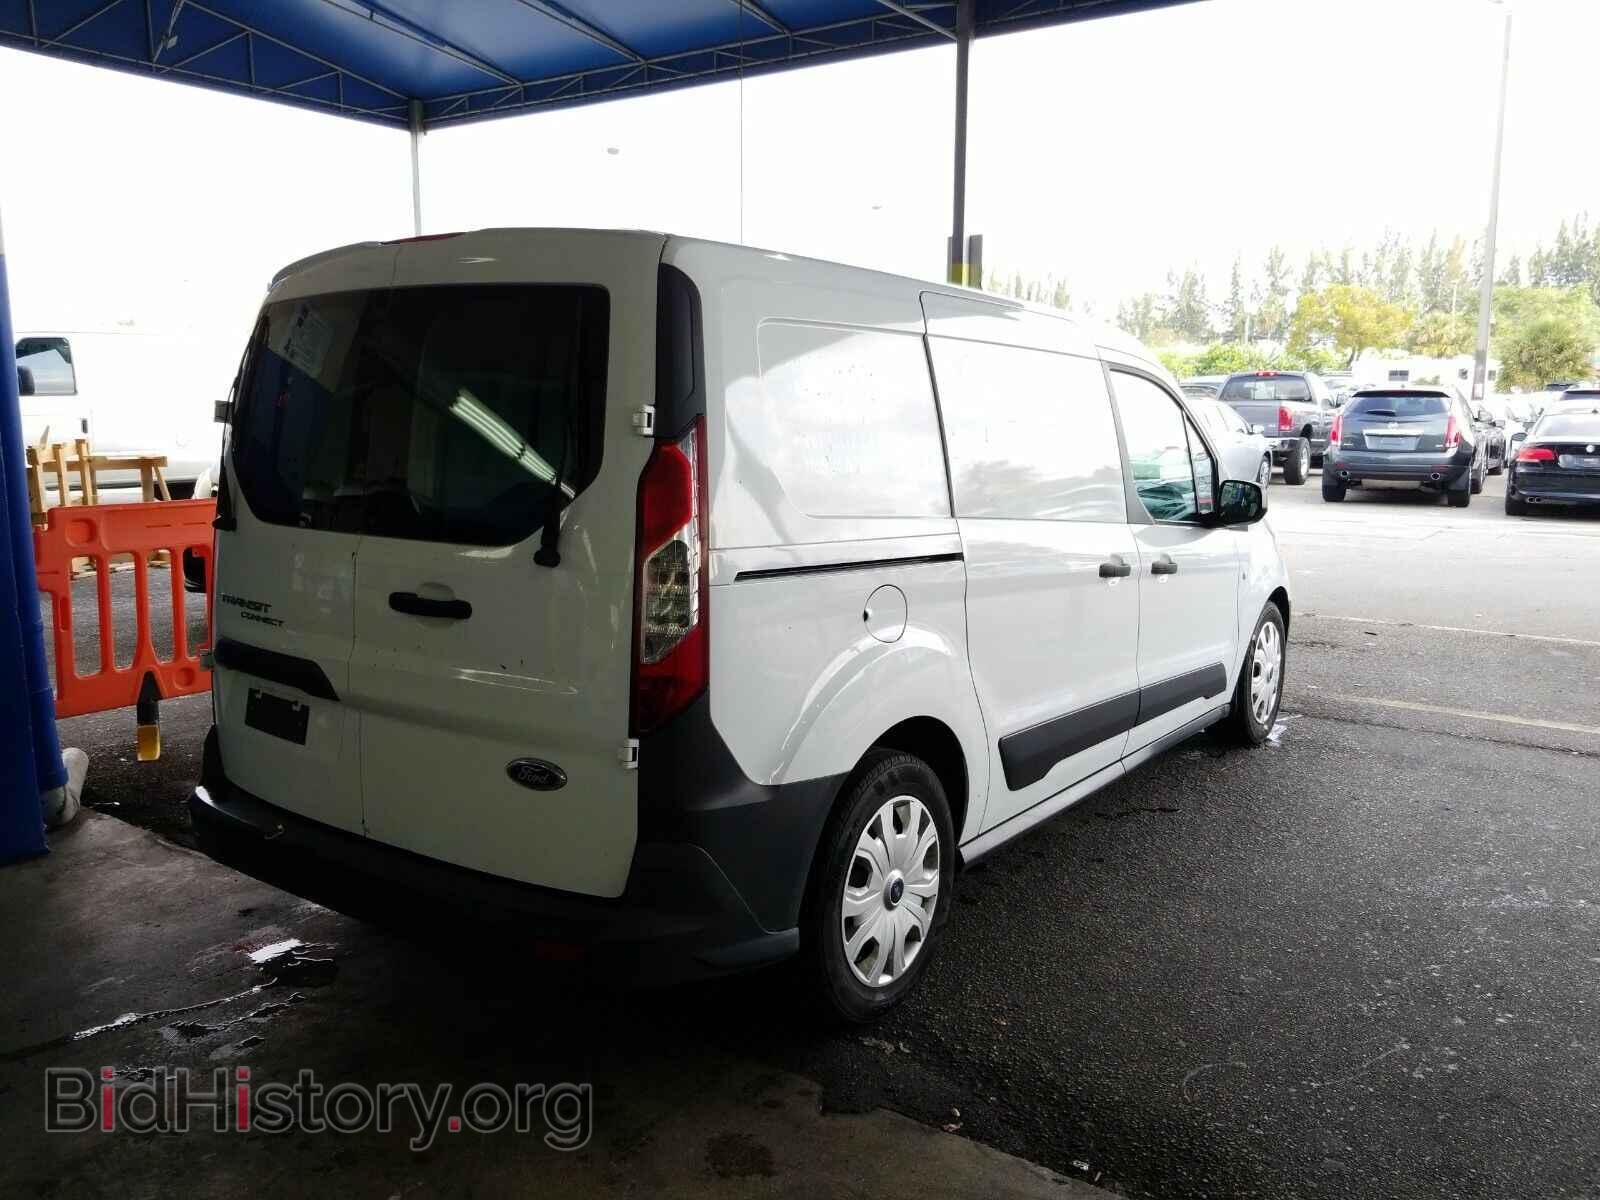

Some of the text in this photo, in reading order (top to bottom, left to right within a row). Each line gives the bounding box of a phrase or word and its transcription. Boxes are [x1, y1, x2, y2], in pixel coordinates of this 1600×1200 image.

[222, 594, 273, 613] TRANSIT
[240, 611, 285, 627] CONNECT
[518, 765, 550, 784] Ford
